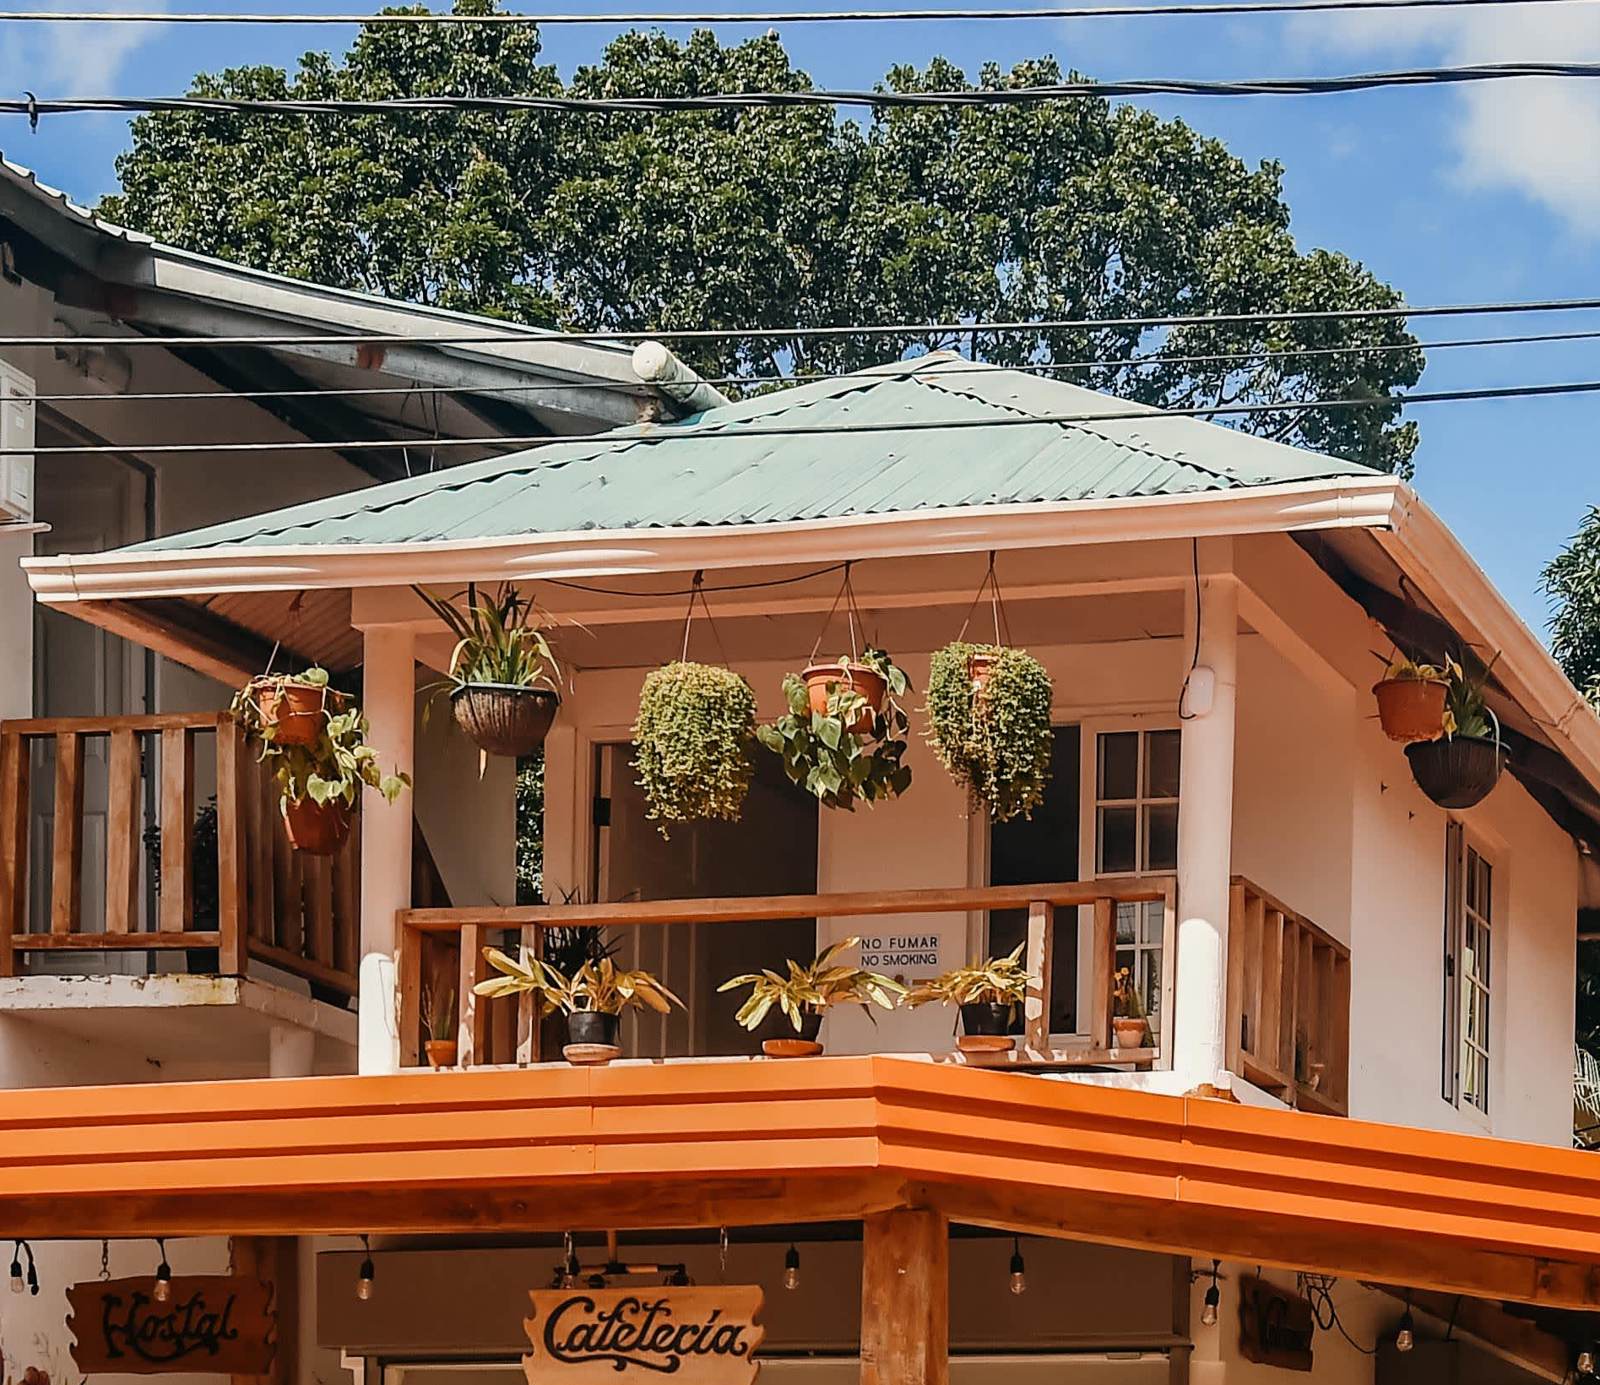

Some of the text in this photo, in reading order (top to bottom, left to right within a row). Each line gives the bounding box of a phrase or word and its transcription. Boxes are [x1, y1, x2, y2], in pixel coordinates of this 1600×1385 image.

[861, 936, 938, 950] NO FUMAR
[861, 953, 937, 967] NO SMOKING
[101, 1290, 239, 1363] Hostal
[544, 1296, 749, 1374] Cafetería
